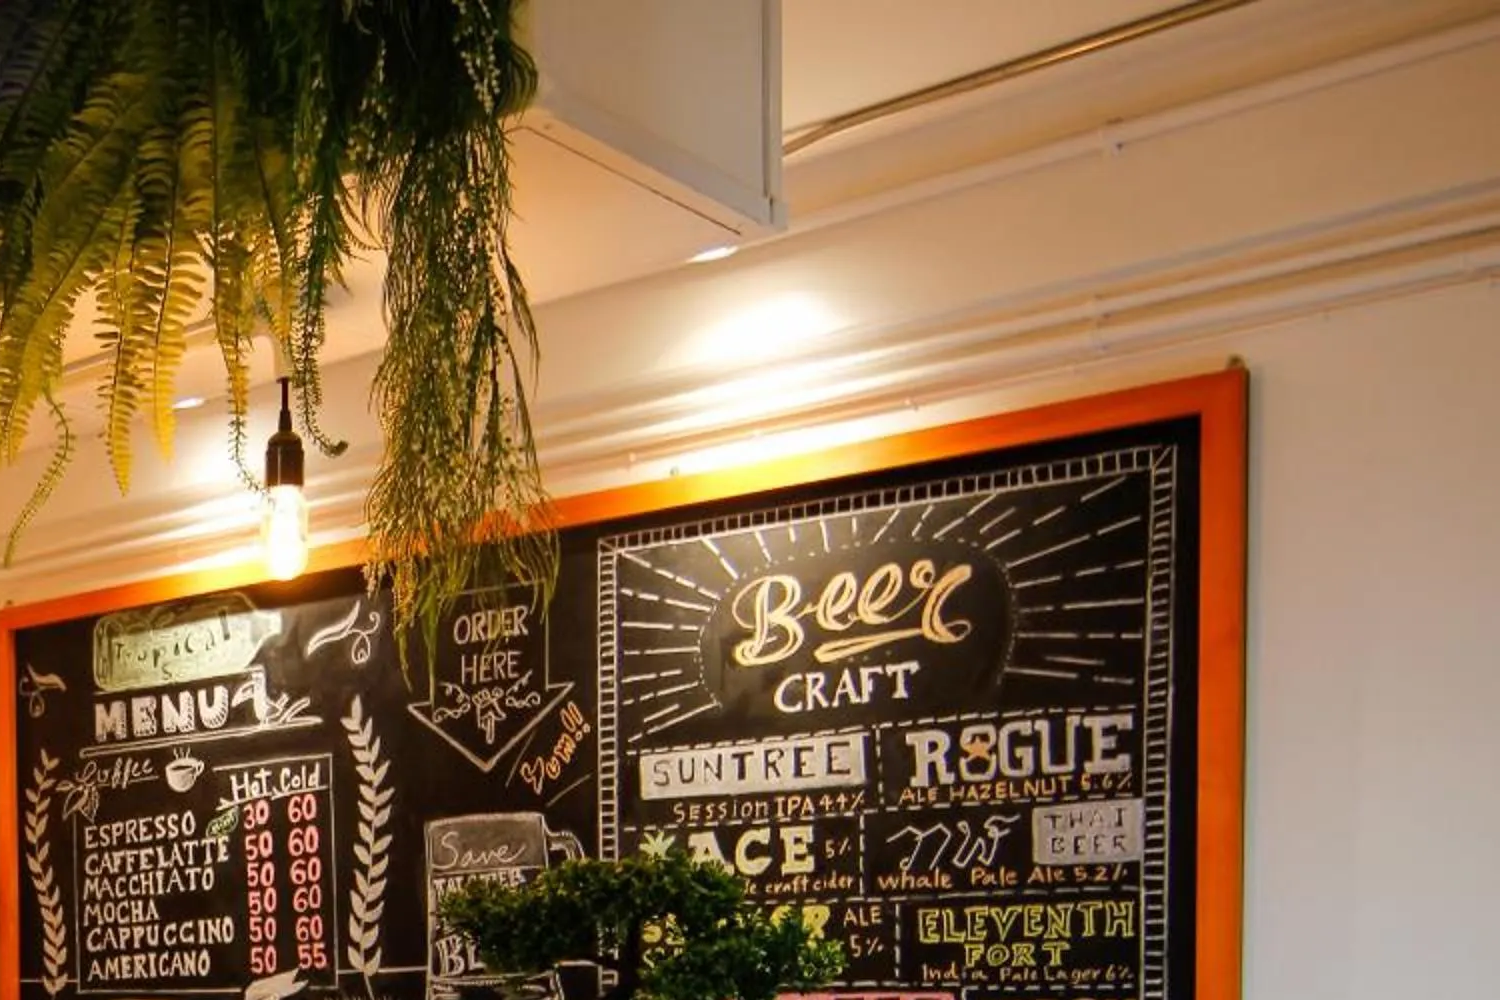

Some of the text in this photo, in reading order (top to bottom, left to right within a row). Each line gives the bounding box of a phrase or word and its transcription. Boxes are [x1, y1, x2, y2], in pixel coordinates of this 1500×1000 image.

[453, 605, 529, 645] ORDER
[731, 559, 972, 667] Beer
[461, 650, 523, 685] HERE
[773, 660, 920, 713] CRAFT
[95, 684, 229, 742] MENU
[653, 741, 851, 787] SUNTREE
[905, 714, 1134, 787] ROGUE
[230, 763, 321, 801] Hot Cold
[900, 786, 939, 802] ALE
[84, 810, 196, 849] ESPRESSO
[243, 799, 270, 830] 30
[288, 793, 317, 823] 60
[775, 795, 815, 817] IPA
[1044, 807, 1127, 829] THAI
[245, 830, 273, 861] 50
[288, 825, 319, 857] 60
[431, 831, 527, 870] Save
[687, 826, 851, 876] ACE 5%
[1051, 835, 1128, 855] BEER
[83, 857, 322, 901] MACCHIATO 50 60
[877, 864, 954, 890] whale
[971, 866, 1019, 886] Pale
[1027, 863, 1066, 884] Ale
[83, 884, 322, 927] MOCHA 50 60
[843, 905, 883, 927] ALE
[917, 901, 1135, 943] ELEVENTH
[86, 915, 323, 953] CAPPUCCINO 50 60
[850, 934, 884, 958] 5%
[87, 943, 327, 983] AMERICANO 50 55
[964, 941, 1071, 967] FORT
[1000, 965, 1038, 982] Pale
[1043, 967, 1100, 983] Lager
